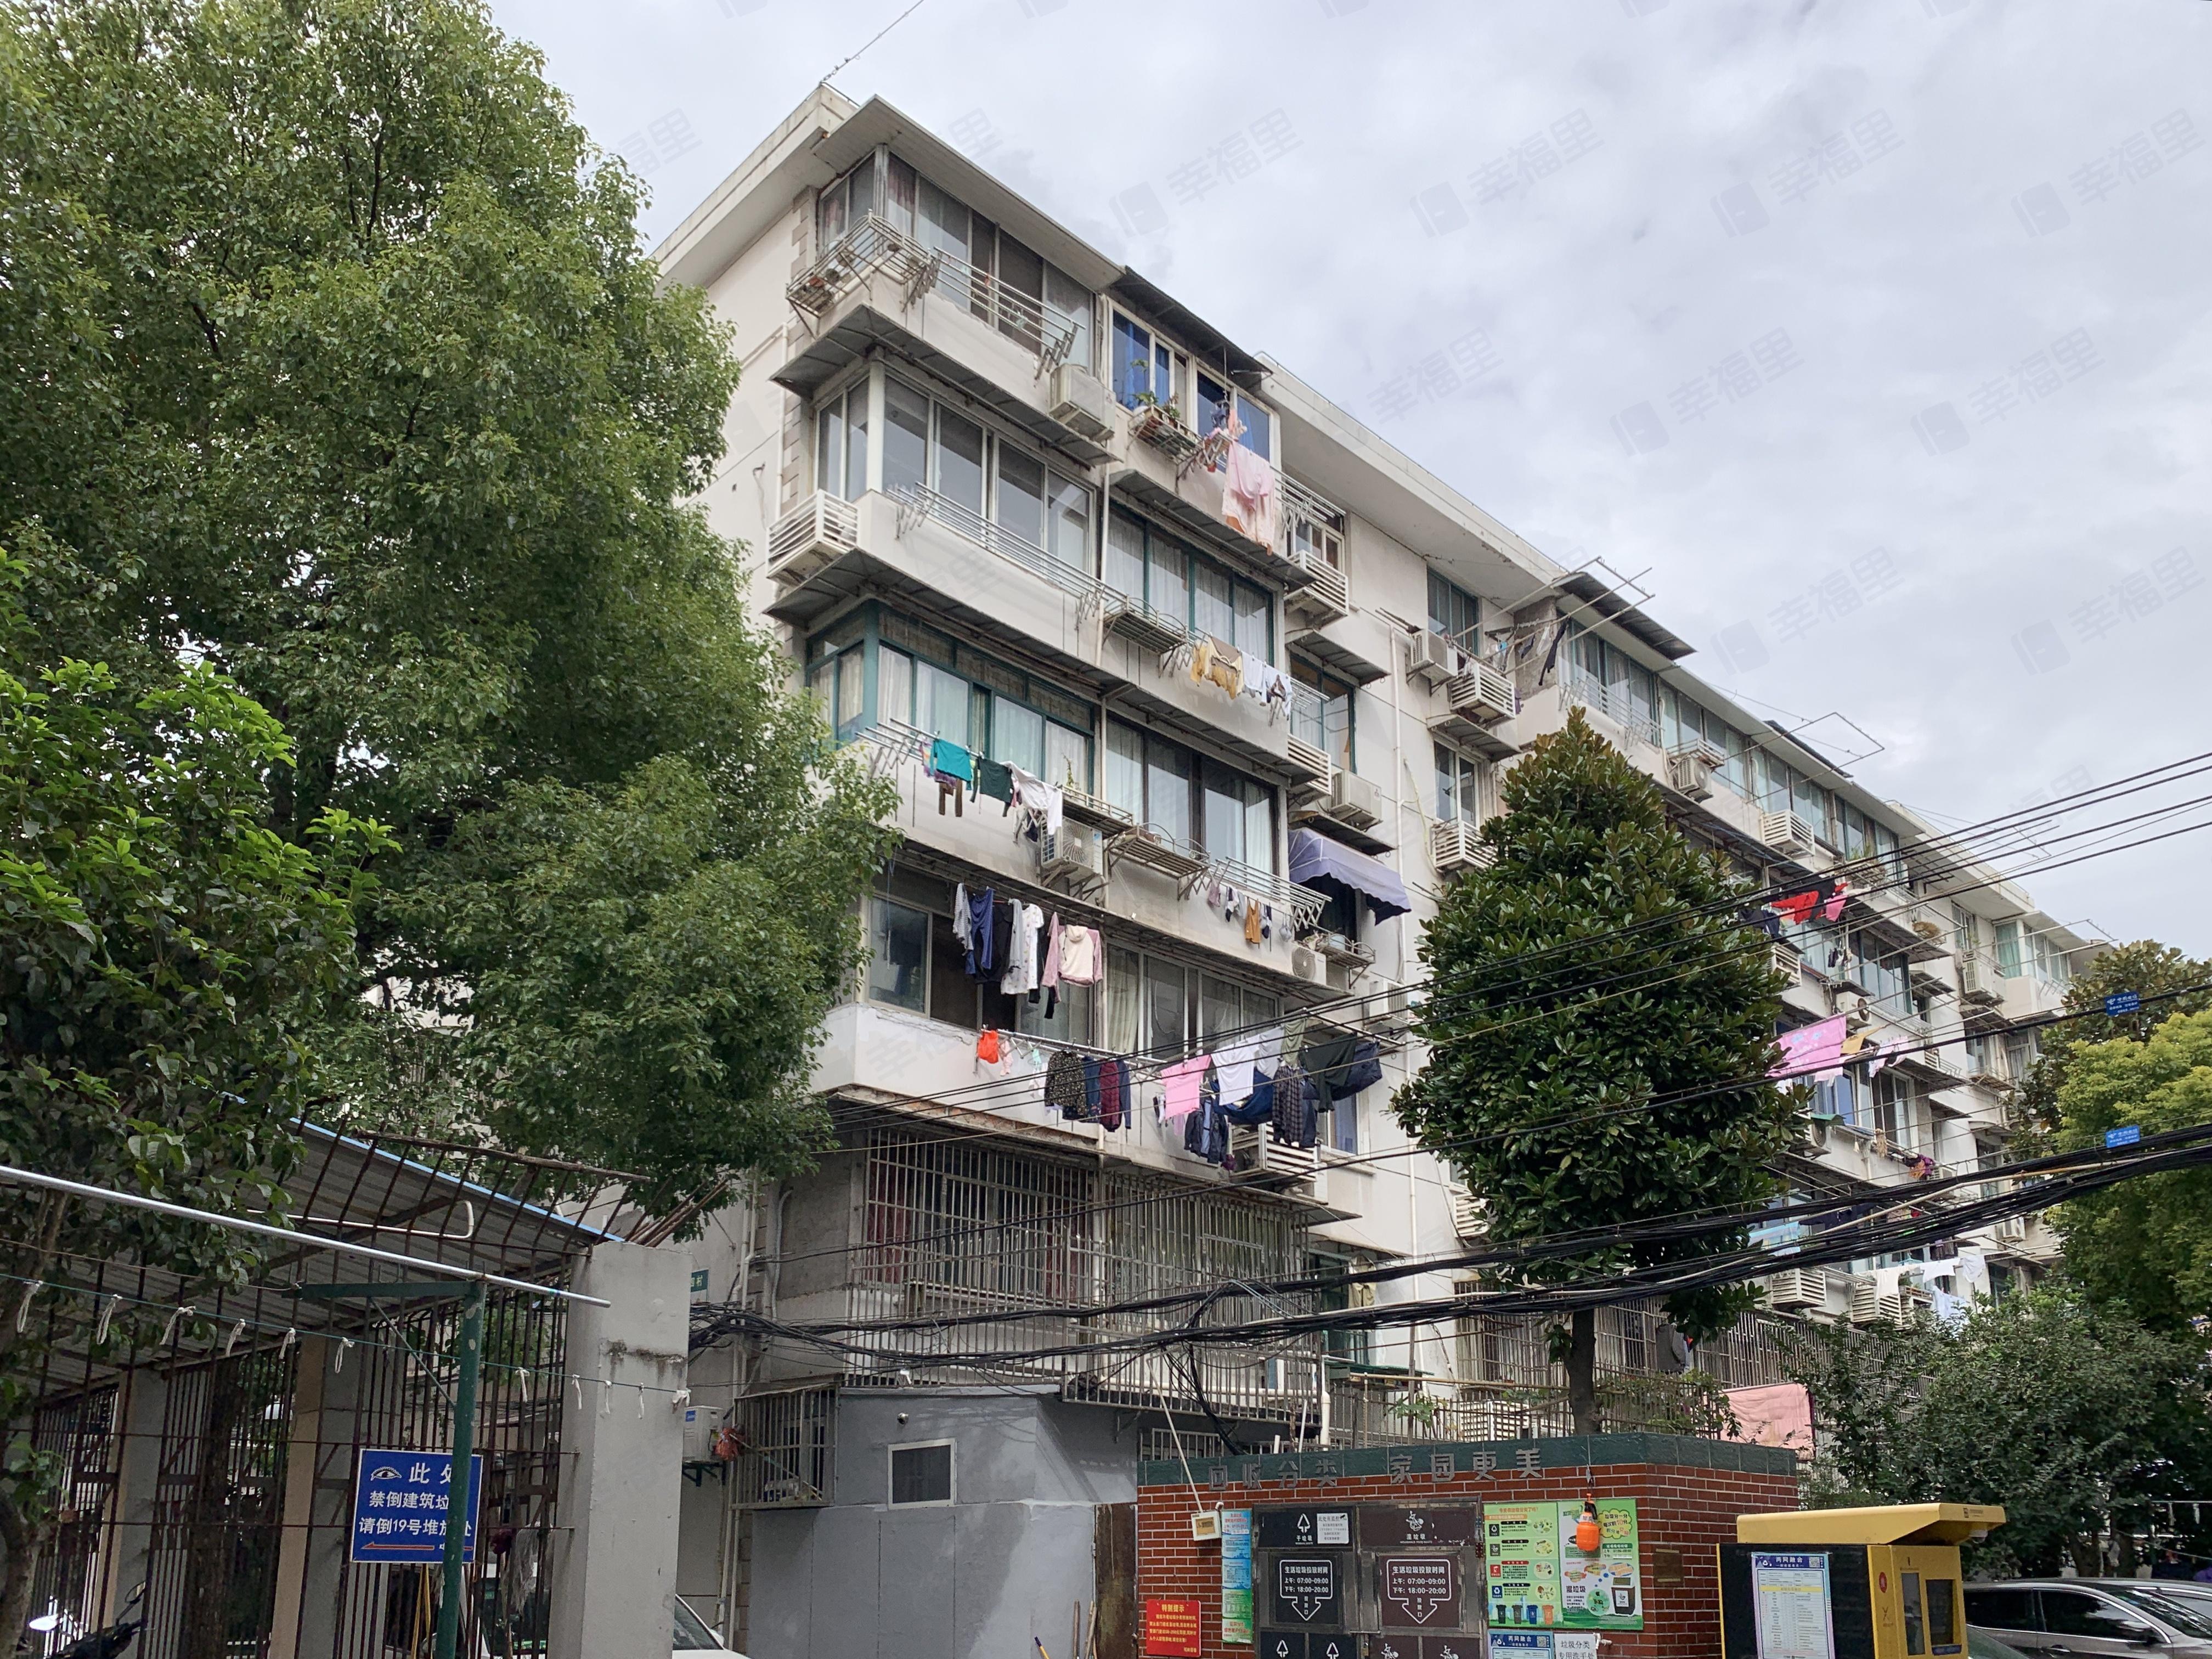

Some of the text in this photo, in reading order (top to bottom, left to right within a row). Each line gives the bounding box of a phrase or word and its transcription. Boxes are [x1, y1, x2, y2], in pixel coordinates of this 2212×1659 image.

[369, 1490, 449, 1510] 禁倒建筑垃
[1392, 1566, 1445, 1575] 生活垃圾投放时间
[1161, 1604, 1184, 1613] 特别提示
[1560, 1640, 1590, 1649] 垃圾分类
